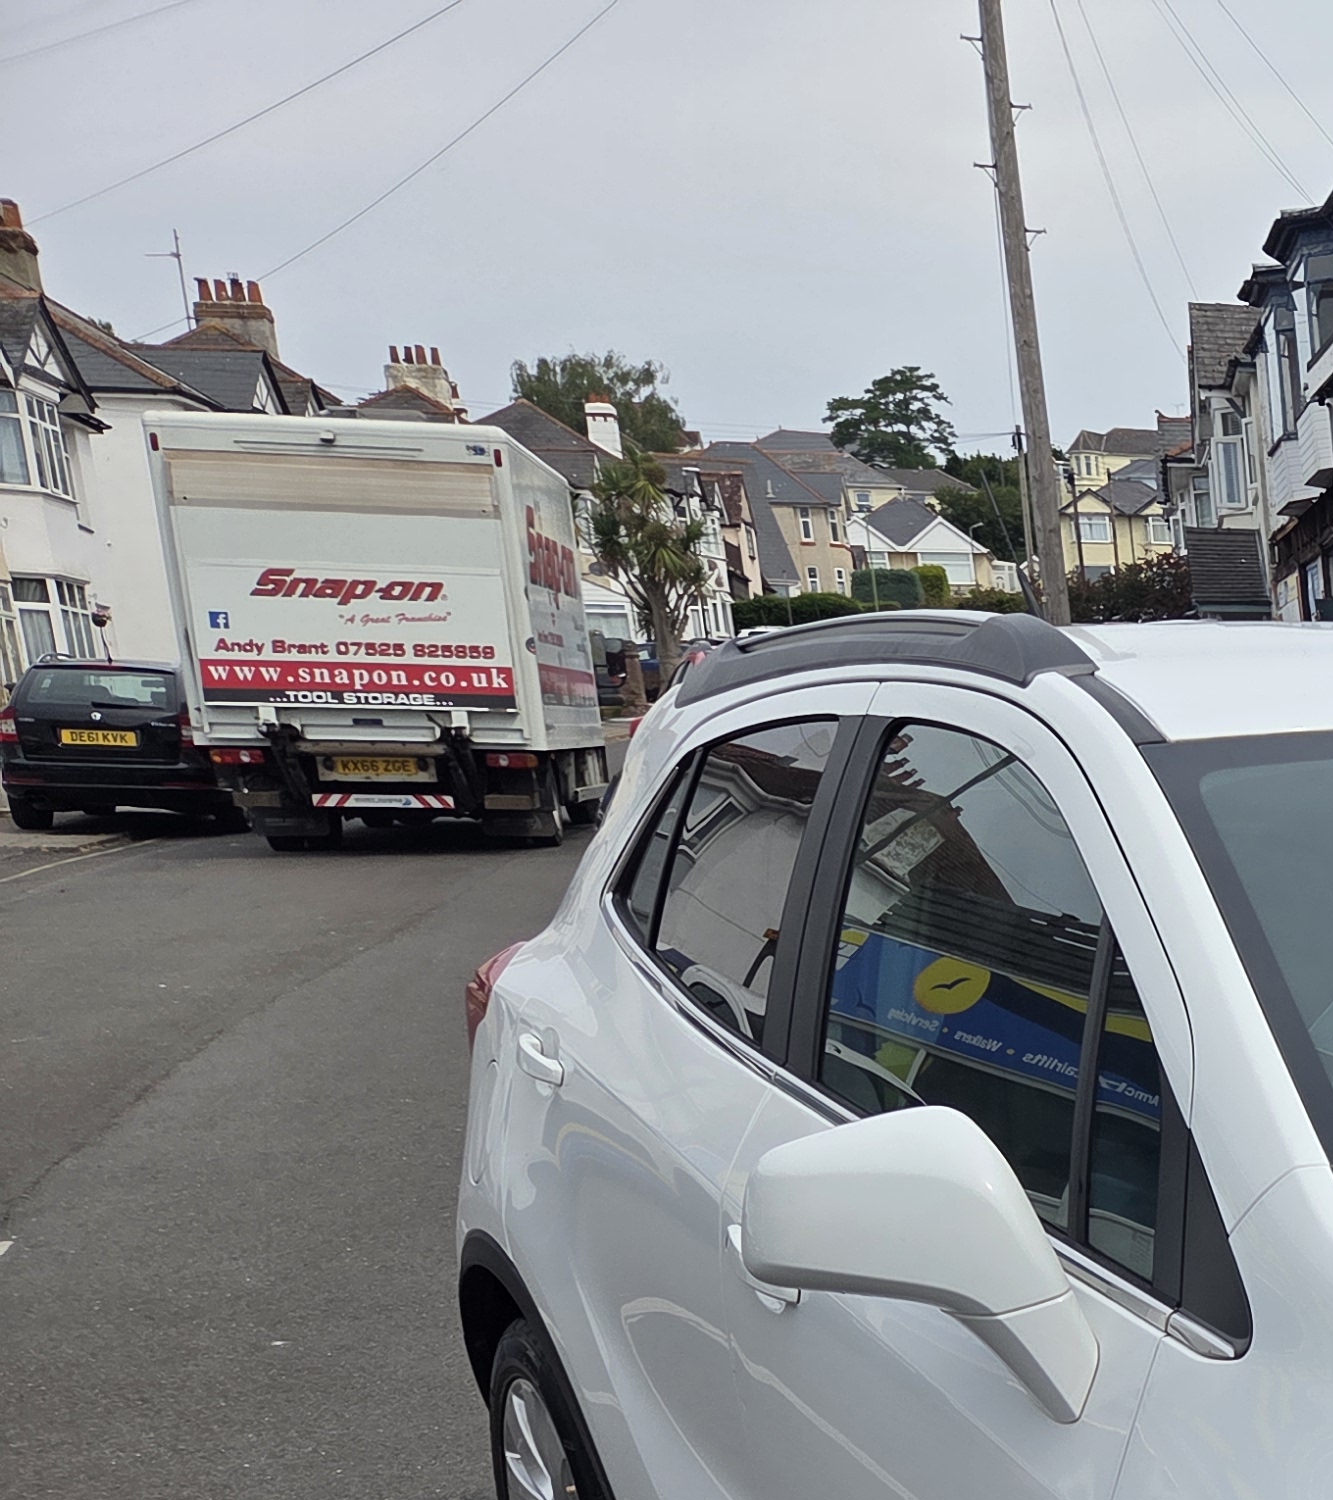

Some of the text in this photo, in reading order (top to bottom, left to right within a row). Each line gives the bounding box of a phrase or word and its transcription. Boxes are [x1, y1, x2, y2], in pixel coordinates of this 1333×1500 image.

[249, 568, 445, 606] Snap-on
[214, 637, 265, 656] Andy
[271, 639, 330, 655] Brant
[335, 641, 406, 657] 07525
[207, 664, 509, 689] www.snapon.co.uk
[70, 731, 129, 744] DE61 KVK
[340, 759, 413, 772] KX66 ZGE
